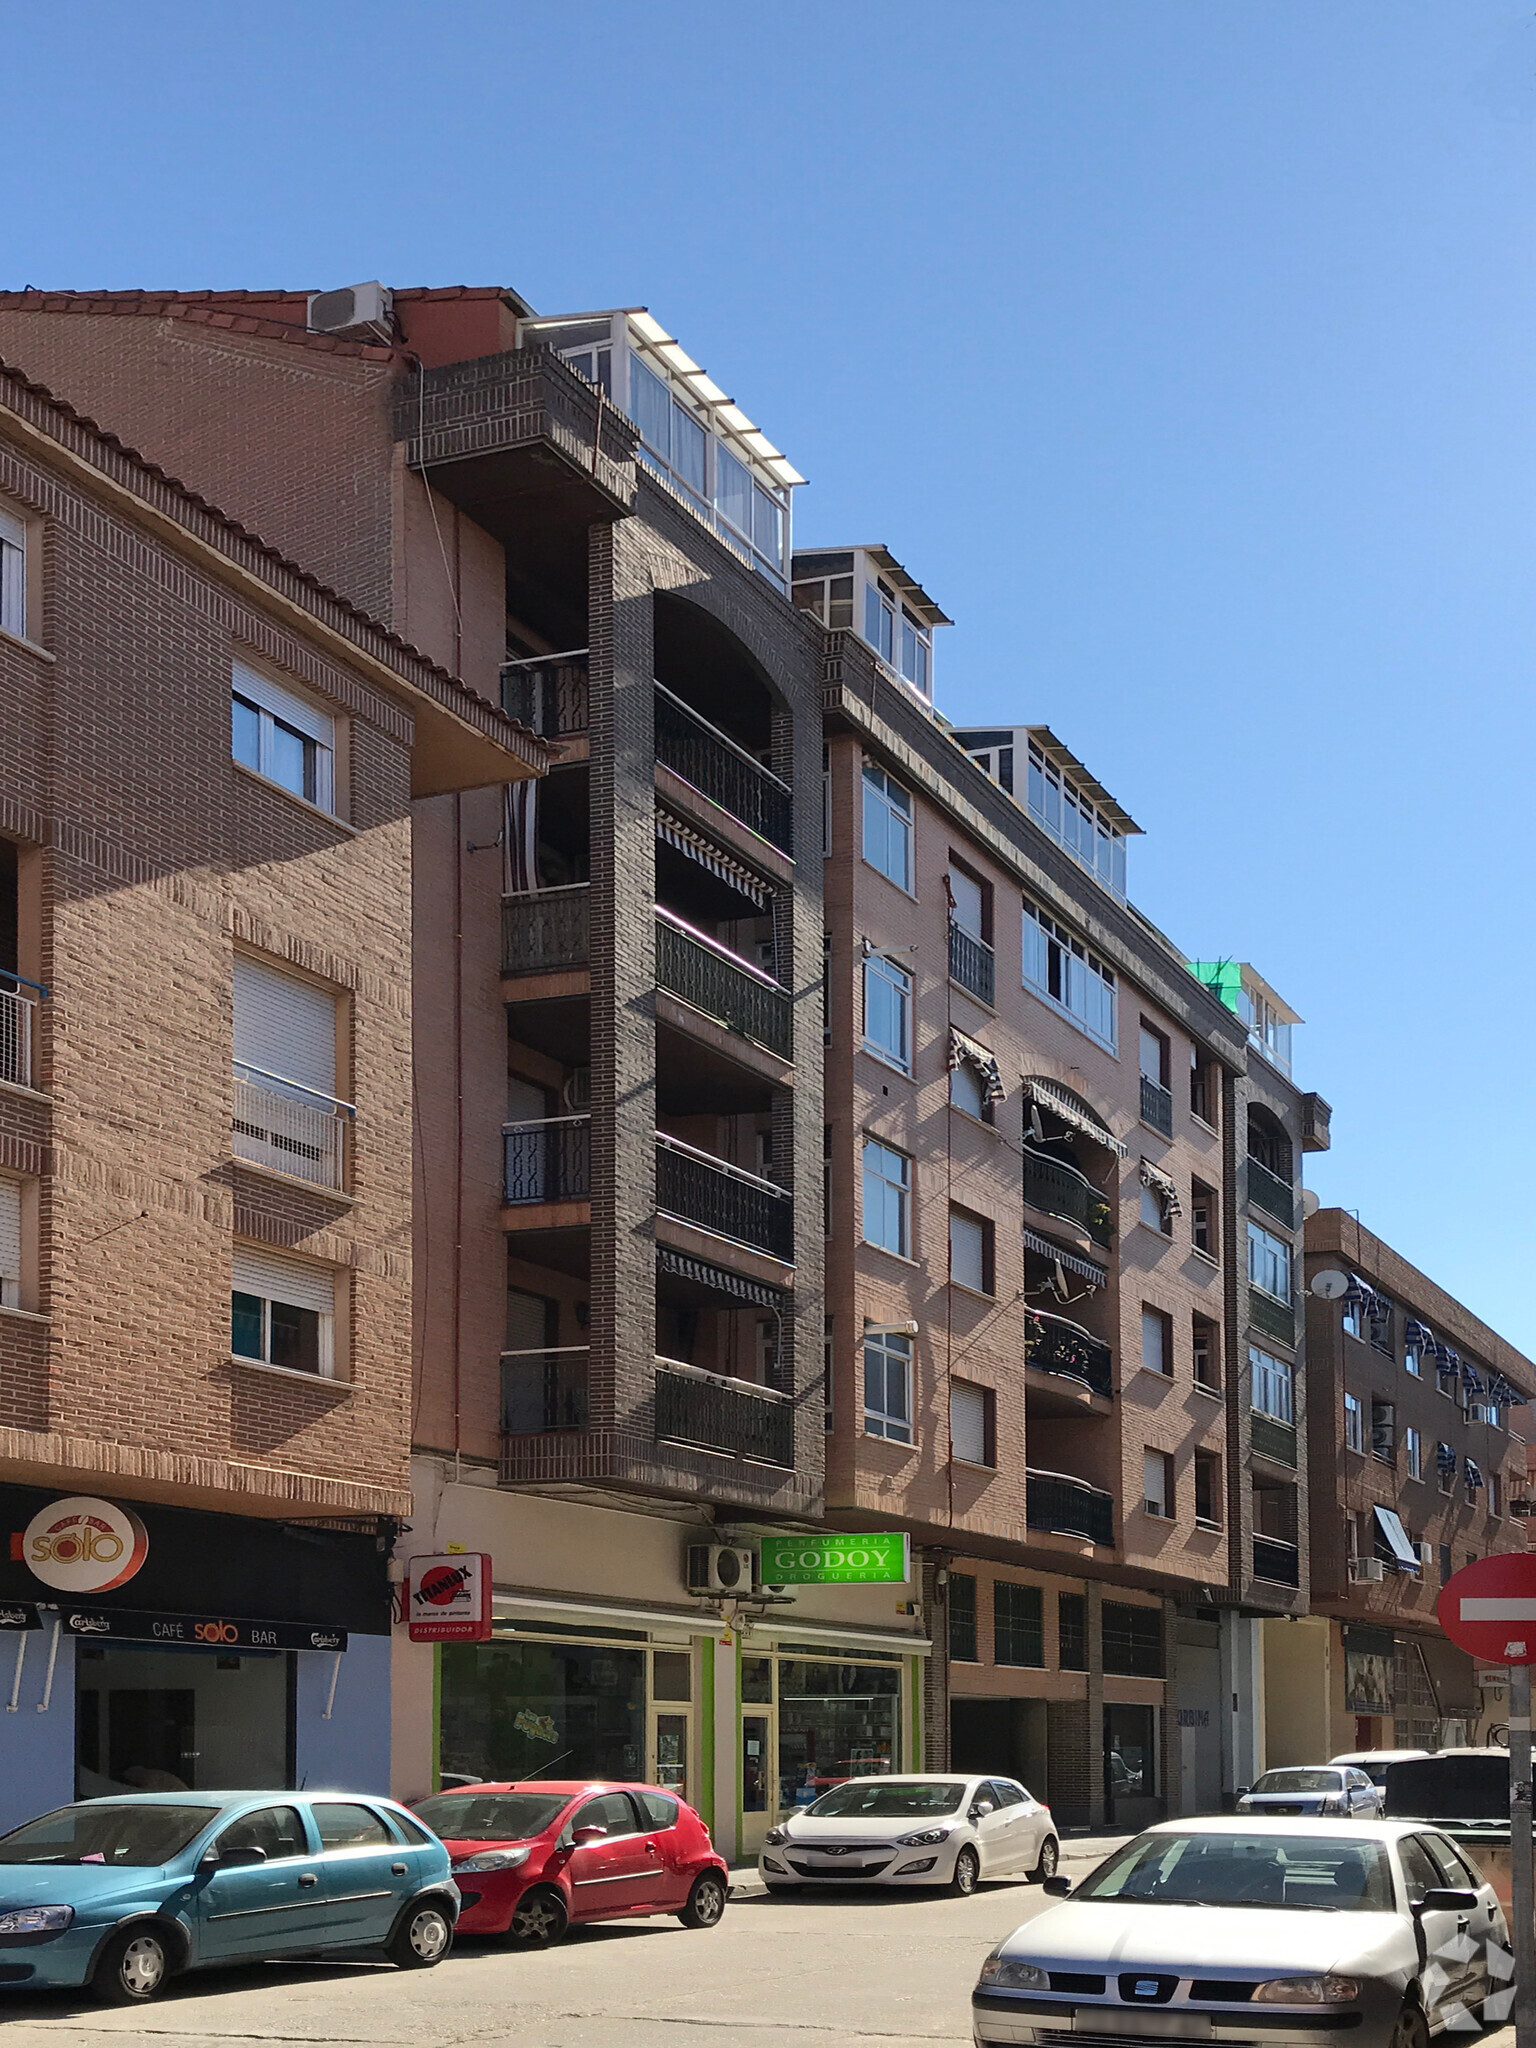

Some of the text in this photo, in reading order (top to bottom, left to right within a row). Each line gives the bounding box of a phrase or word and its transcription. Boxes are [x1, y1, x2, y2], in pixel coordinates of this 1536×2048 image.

[775, 1537, 890, 1548] PERFUMERIA
[774, 1549, 890, 1569] GODOY
[775, 1571, 890, 1581] DROGUERIA
[413, 1565, 473, 1606] TITANLUX
[69, 1614, 110, 1632] Carlsberg
[414, 1626, 473, 1634] DISTRIBUIDOR
[152, 1622, 184, 1639] CAFÉ
[251, 1630, 277, 1645] BAR
